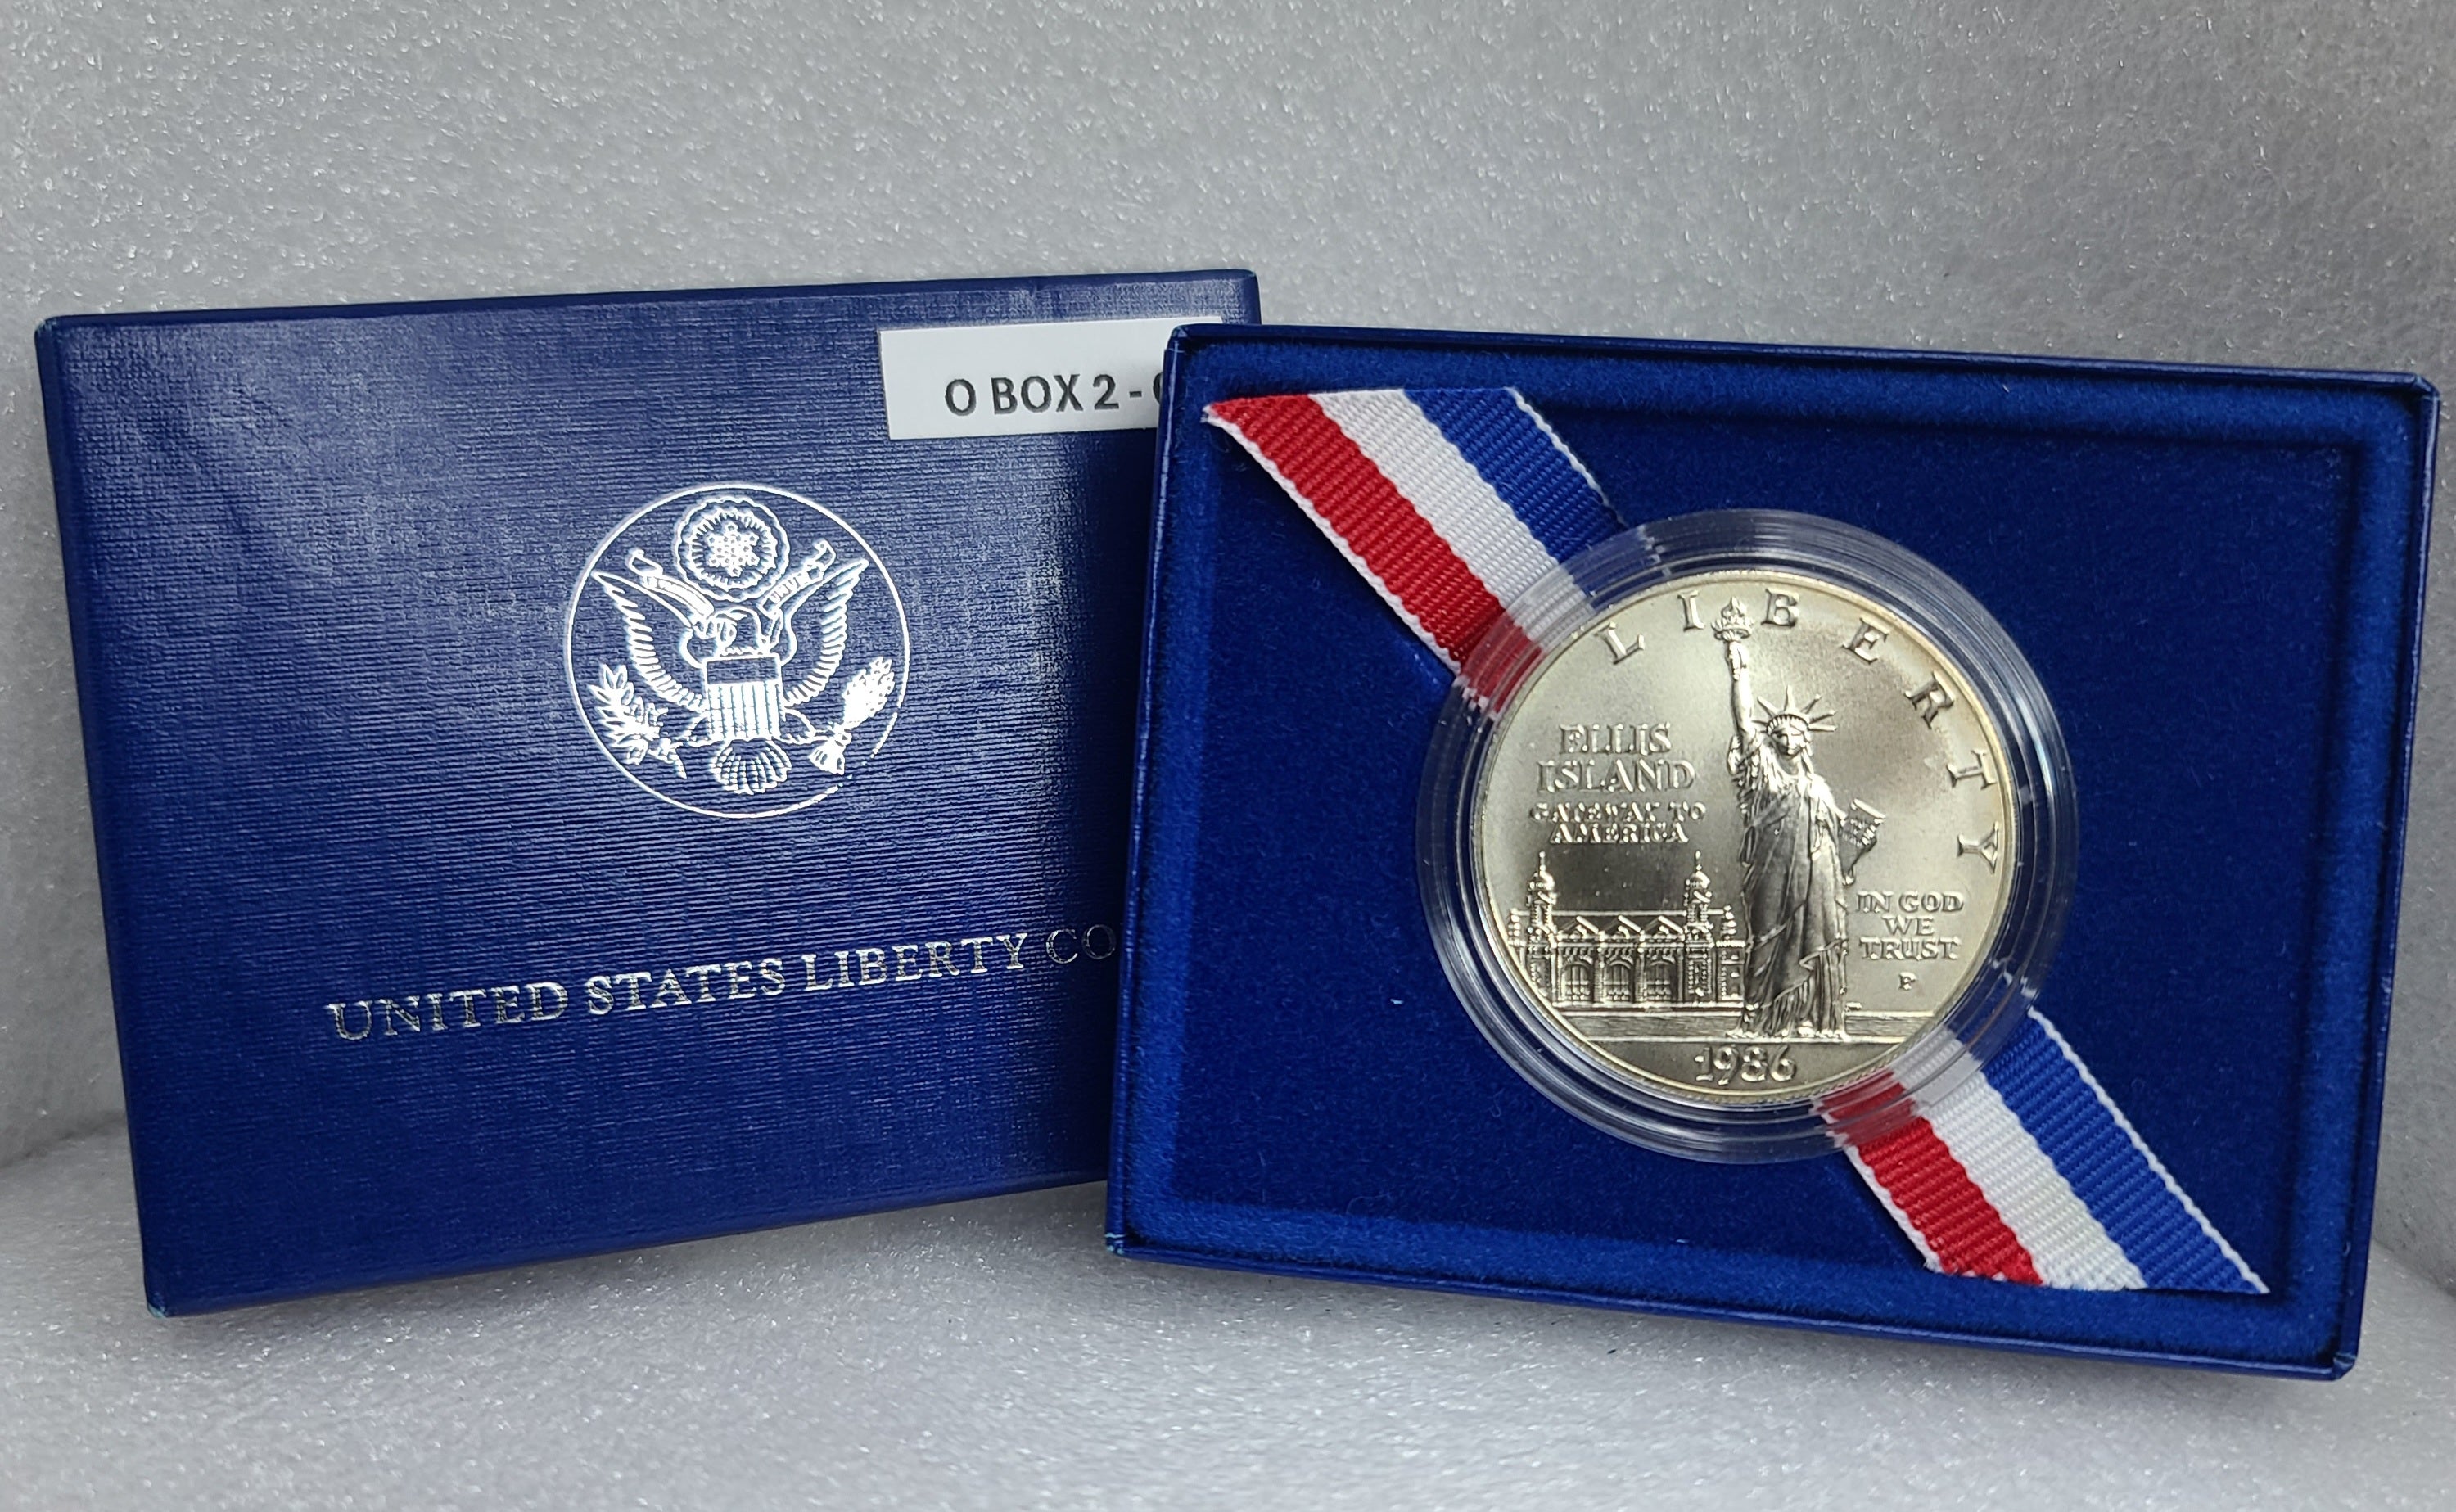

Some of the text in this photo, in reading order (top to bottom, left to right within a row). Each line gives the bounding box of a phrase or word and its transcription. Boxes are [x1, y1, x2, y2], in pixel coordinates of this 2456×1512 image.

[945, 377, 977, 417] O
[1559, 721, 1672, 756] ELLIS
[1595, 588, 2000, 874] LIBERTY
[1536, 758, 1695, 793] ISLAND
[1668, 801, 1707, 823] TO
[1550, 821, 1690, 844] AMERICA
[1856, 890, 1965, 914] IN GOD
[1881, 914, 1935, 936] WE
[1859, 936, 1962, 961] TRUST
[327, 982, 568, 1040] UNITED
[585, 957, 786, 1015] STATES
[800, 932, 1028, 992] LIBERTY
[1693, 1043, 1797, 1085] 1986
